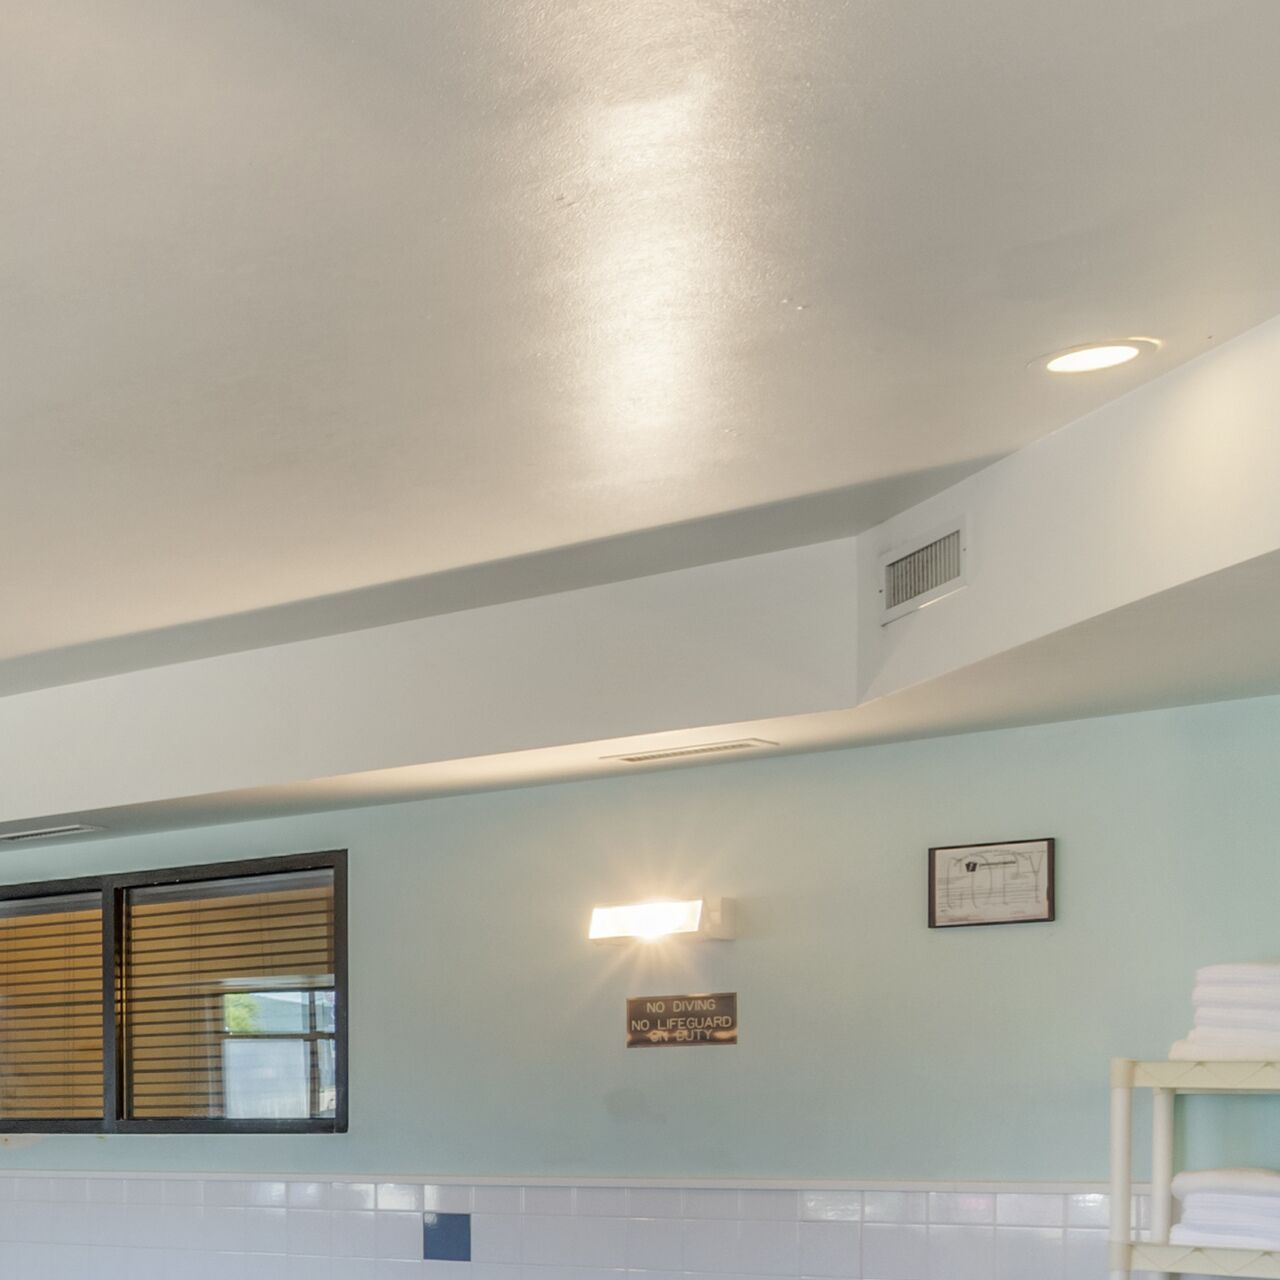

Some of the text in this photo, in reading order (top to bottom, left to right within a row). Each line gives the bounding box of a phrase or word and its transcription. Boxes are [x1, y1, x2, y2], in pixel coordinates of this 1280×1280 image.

[646, 999, 716, 1013] NO DIVING
[631, 1016, 732, 1031] NO LIFEGUARD
[649, 1029, 713, 1042] ON DUTY
